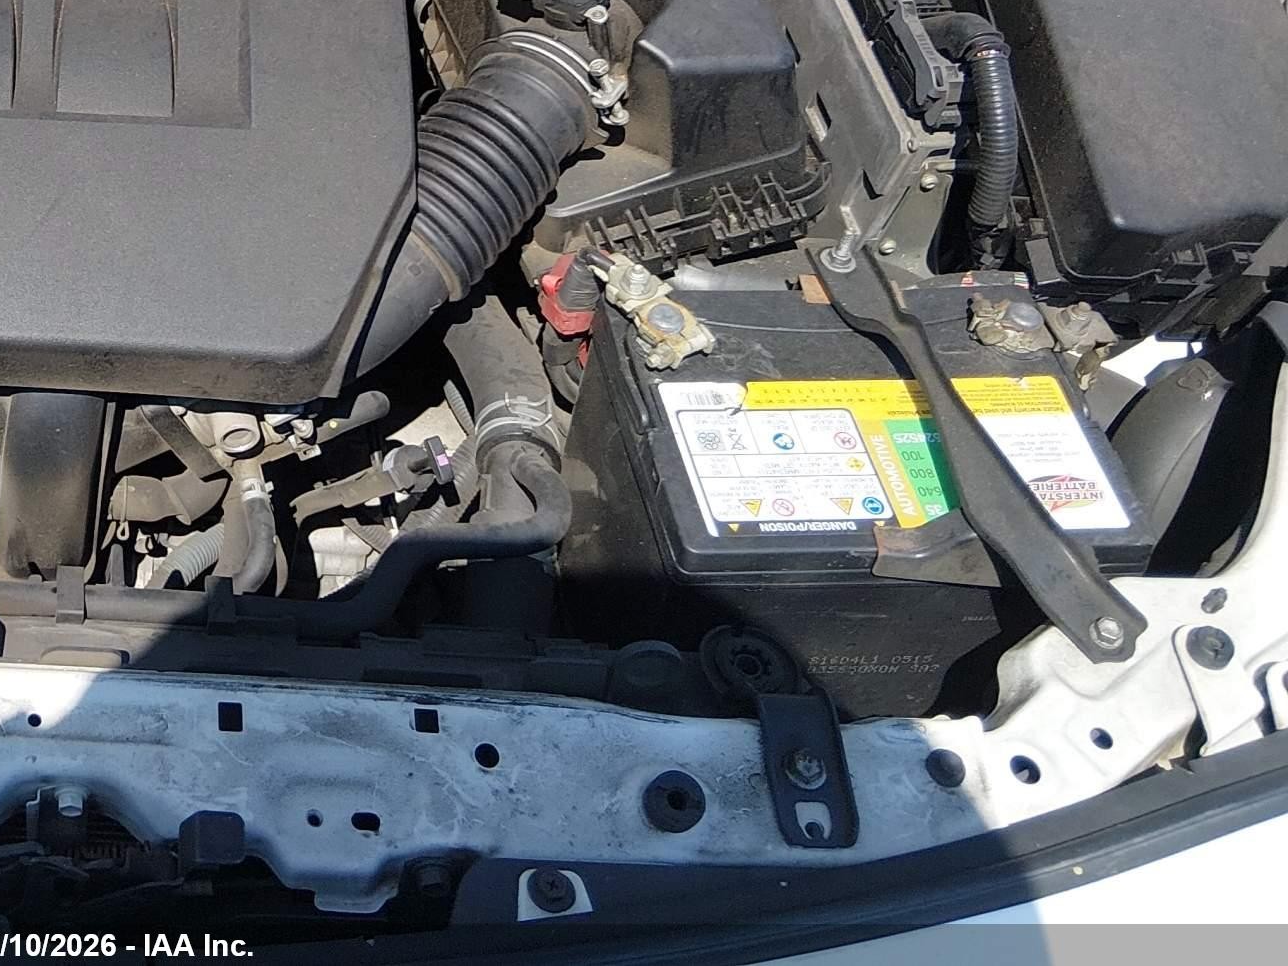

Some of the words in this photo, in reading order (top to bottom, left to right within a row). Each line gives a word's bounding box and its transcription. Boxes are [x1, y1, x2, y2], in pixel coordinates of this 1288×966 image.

[870, 434, 918, 515] AUTOMOTIVE
[909, 468, 934, 479] 800
[1039, 491, 1104, 501] INTERSTA
[758, 520, 857, 532] DANGER/POISON
